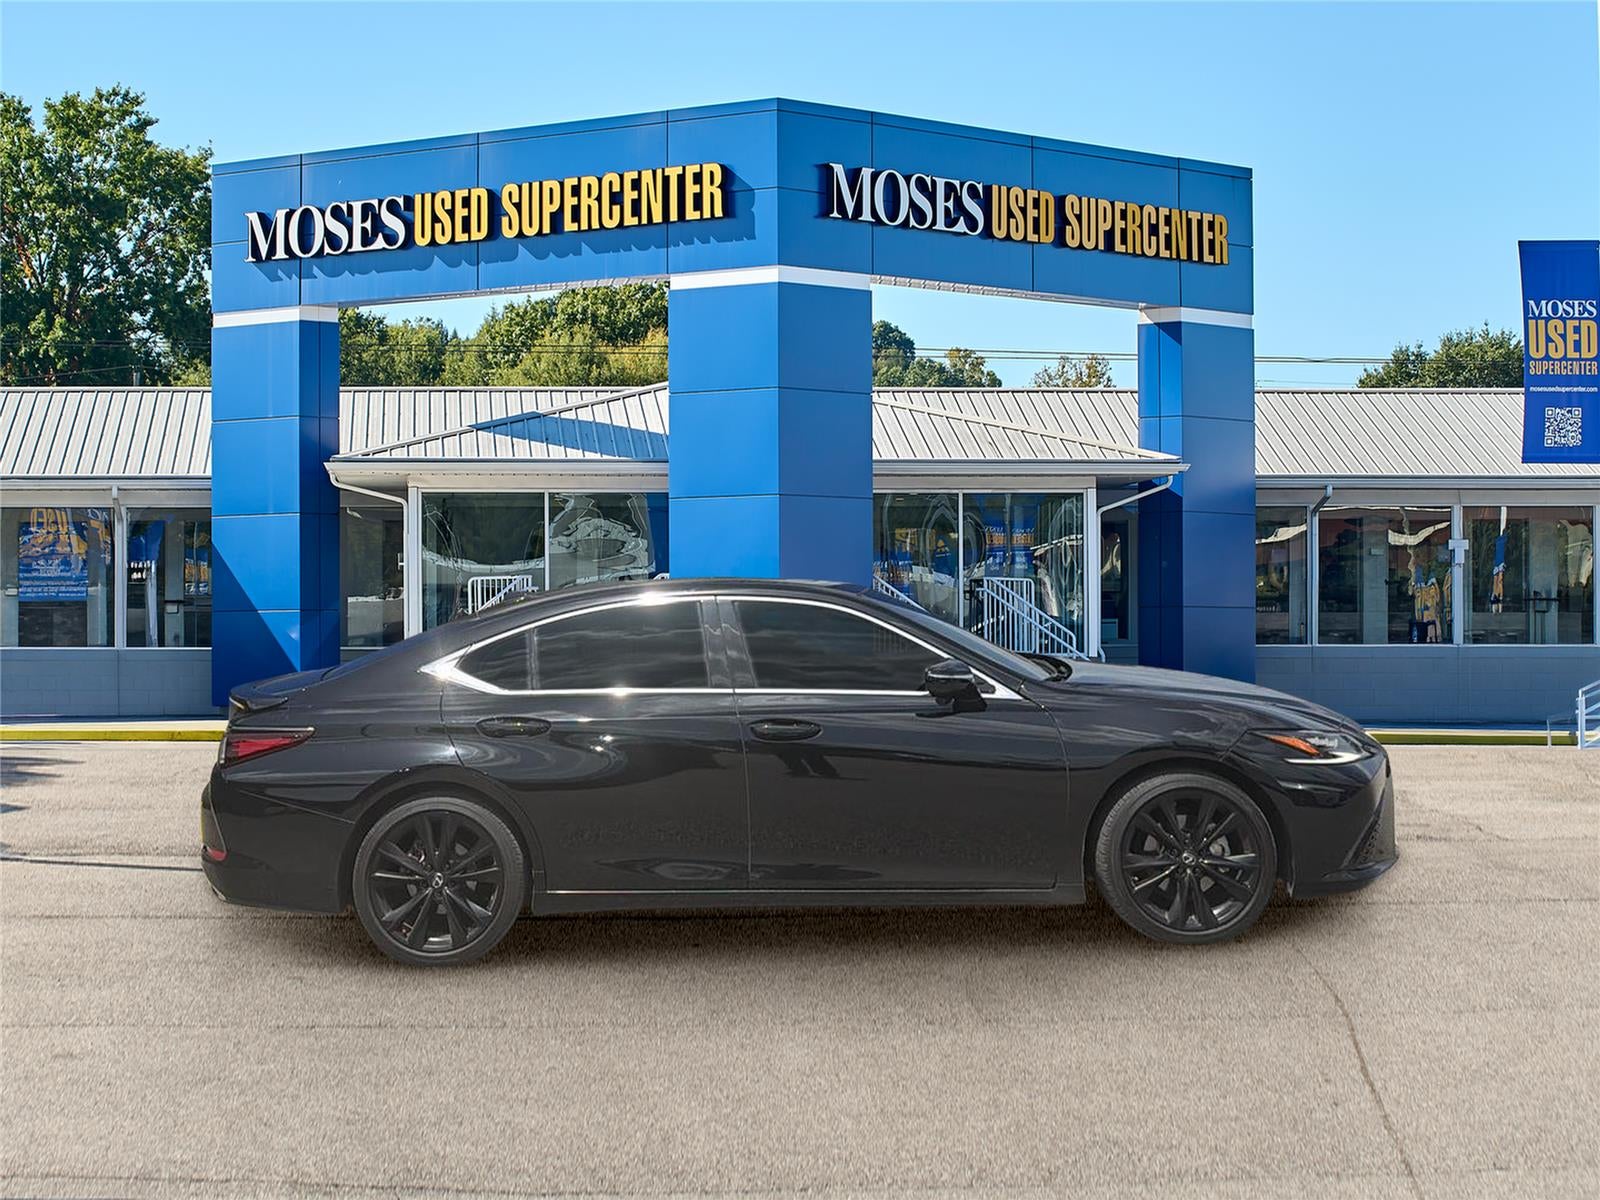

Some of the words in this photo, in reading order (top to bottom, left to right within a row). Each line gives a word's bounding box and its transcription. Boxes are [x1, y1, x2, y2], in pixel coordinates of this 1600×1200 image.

[245, 196, 406, 263] MOSES
[414, 187, 489, 247] USED
[501, 162, 724, 239] SUPERCENTER
[829, 163, 985, 236] MOSES
[991, 184, 1056, 244] USED
[1065, 194, 1230, 265] SUPERCENTER
[1528, 299, 1597, 318] MOSES
[1528, 319, 1598, 359] USED
[1529, 361, 1598, 375] SUPERCENTER
